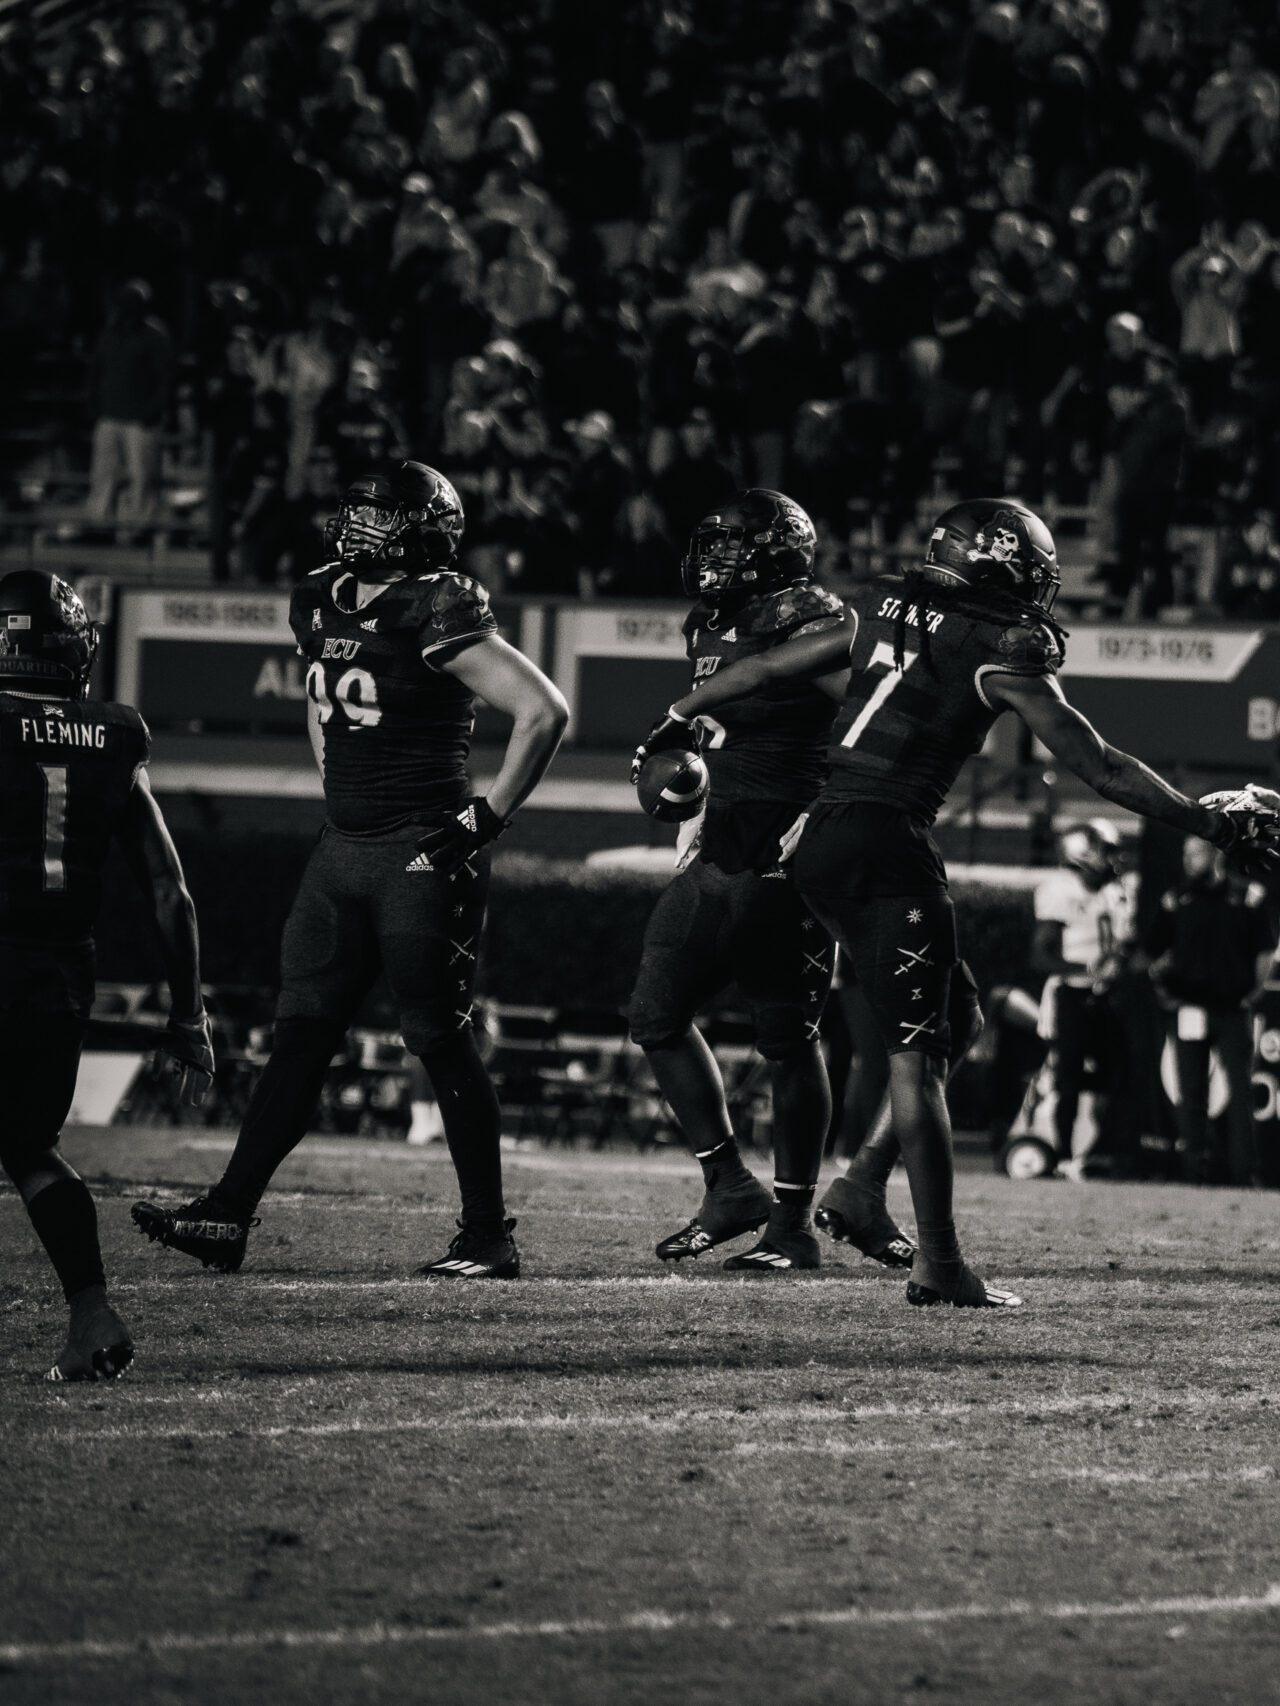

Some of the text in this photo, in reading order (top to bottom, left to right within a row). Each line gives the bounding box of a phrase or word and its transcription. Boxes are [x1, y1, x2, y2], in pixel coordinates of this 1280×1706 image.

[320, 637, 362, 661] ECU
[837, 640, 919, 748] 7
[20, 717, 107, 749] FLEMING
[36, 762, 70, 892] 1
[405, 863, 435, 872] adidas
